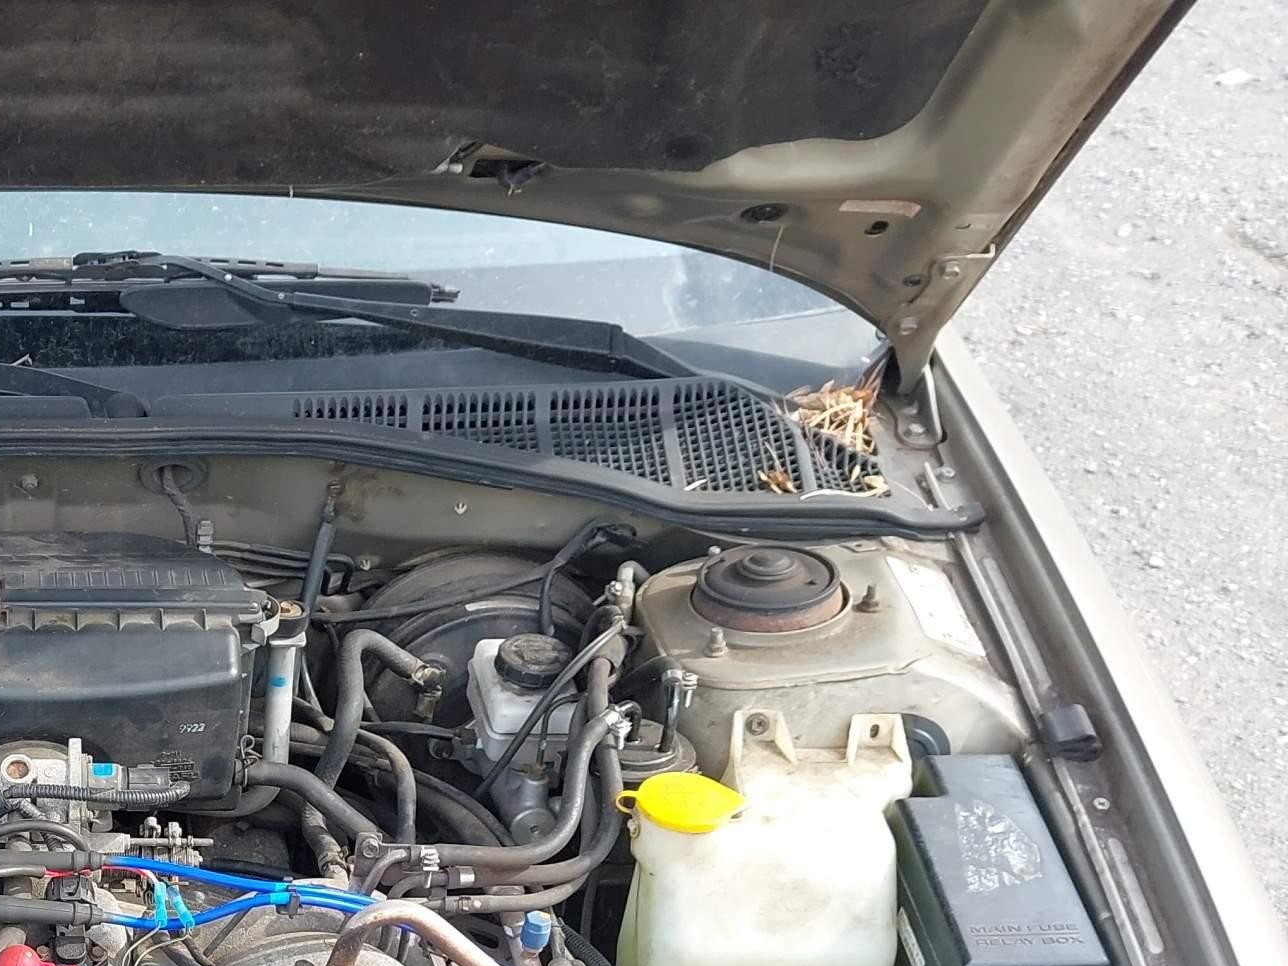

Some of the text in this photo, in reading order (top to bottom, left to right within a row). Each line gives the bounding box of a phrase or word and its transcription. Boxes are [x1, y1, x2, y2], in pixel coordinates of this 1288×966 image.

[970, 923, 1079, 934] MAIN FUSE
[975, 936, 1083, 947] RELAY BOX
